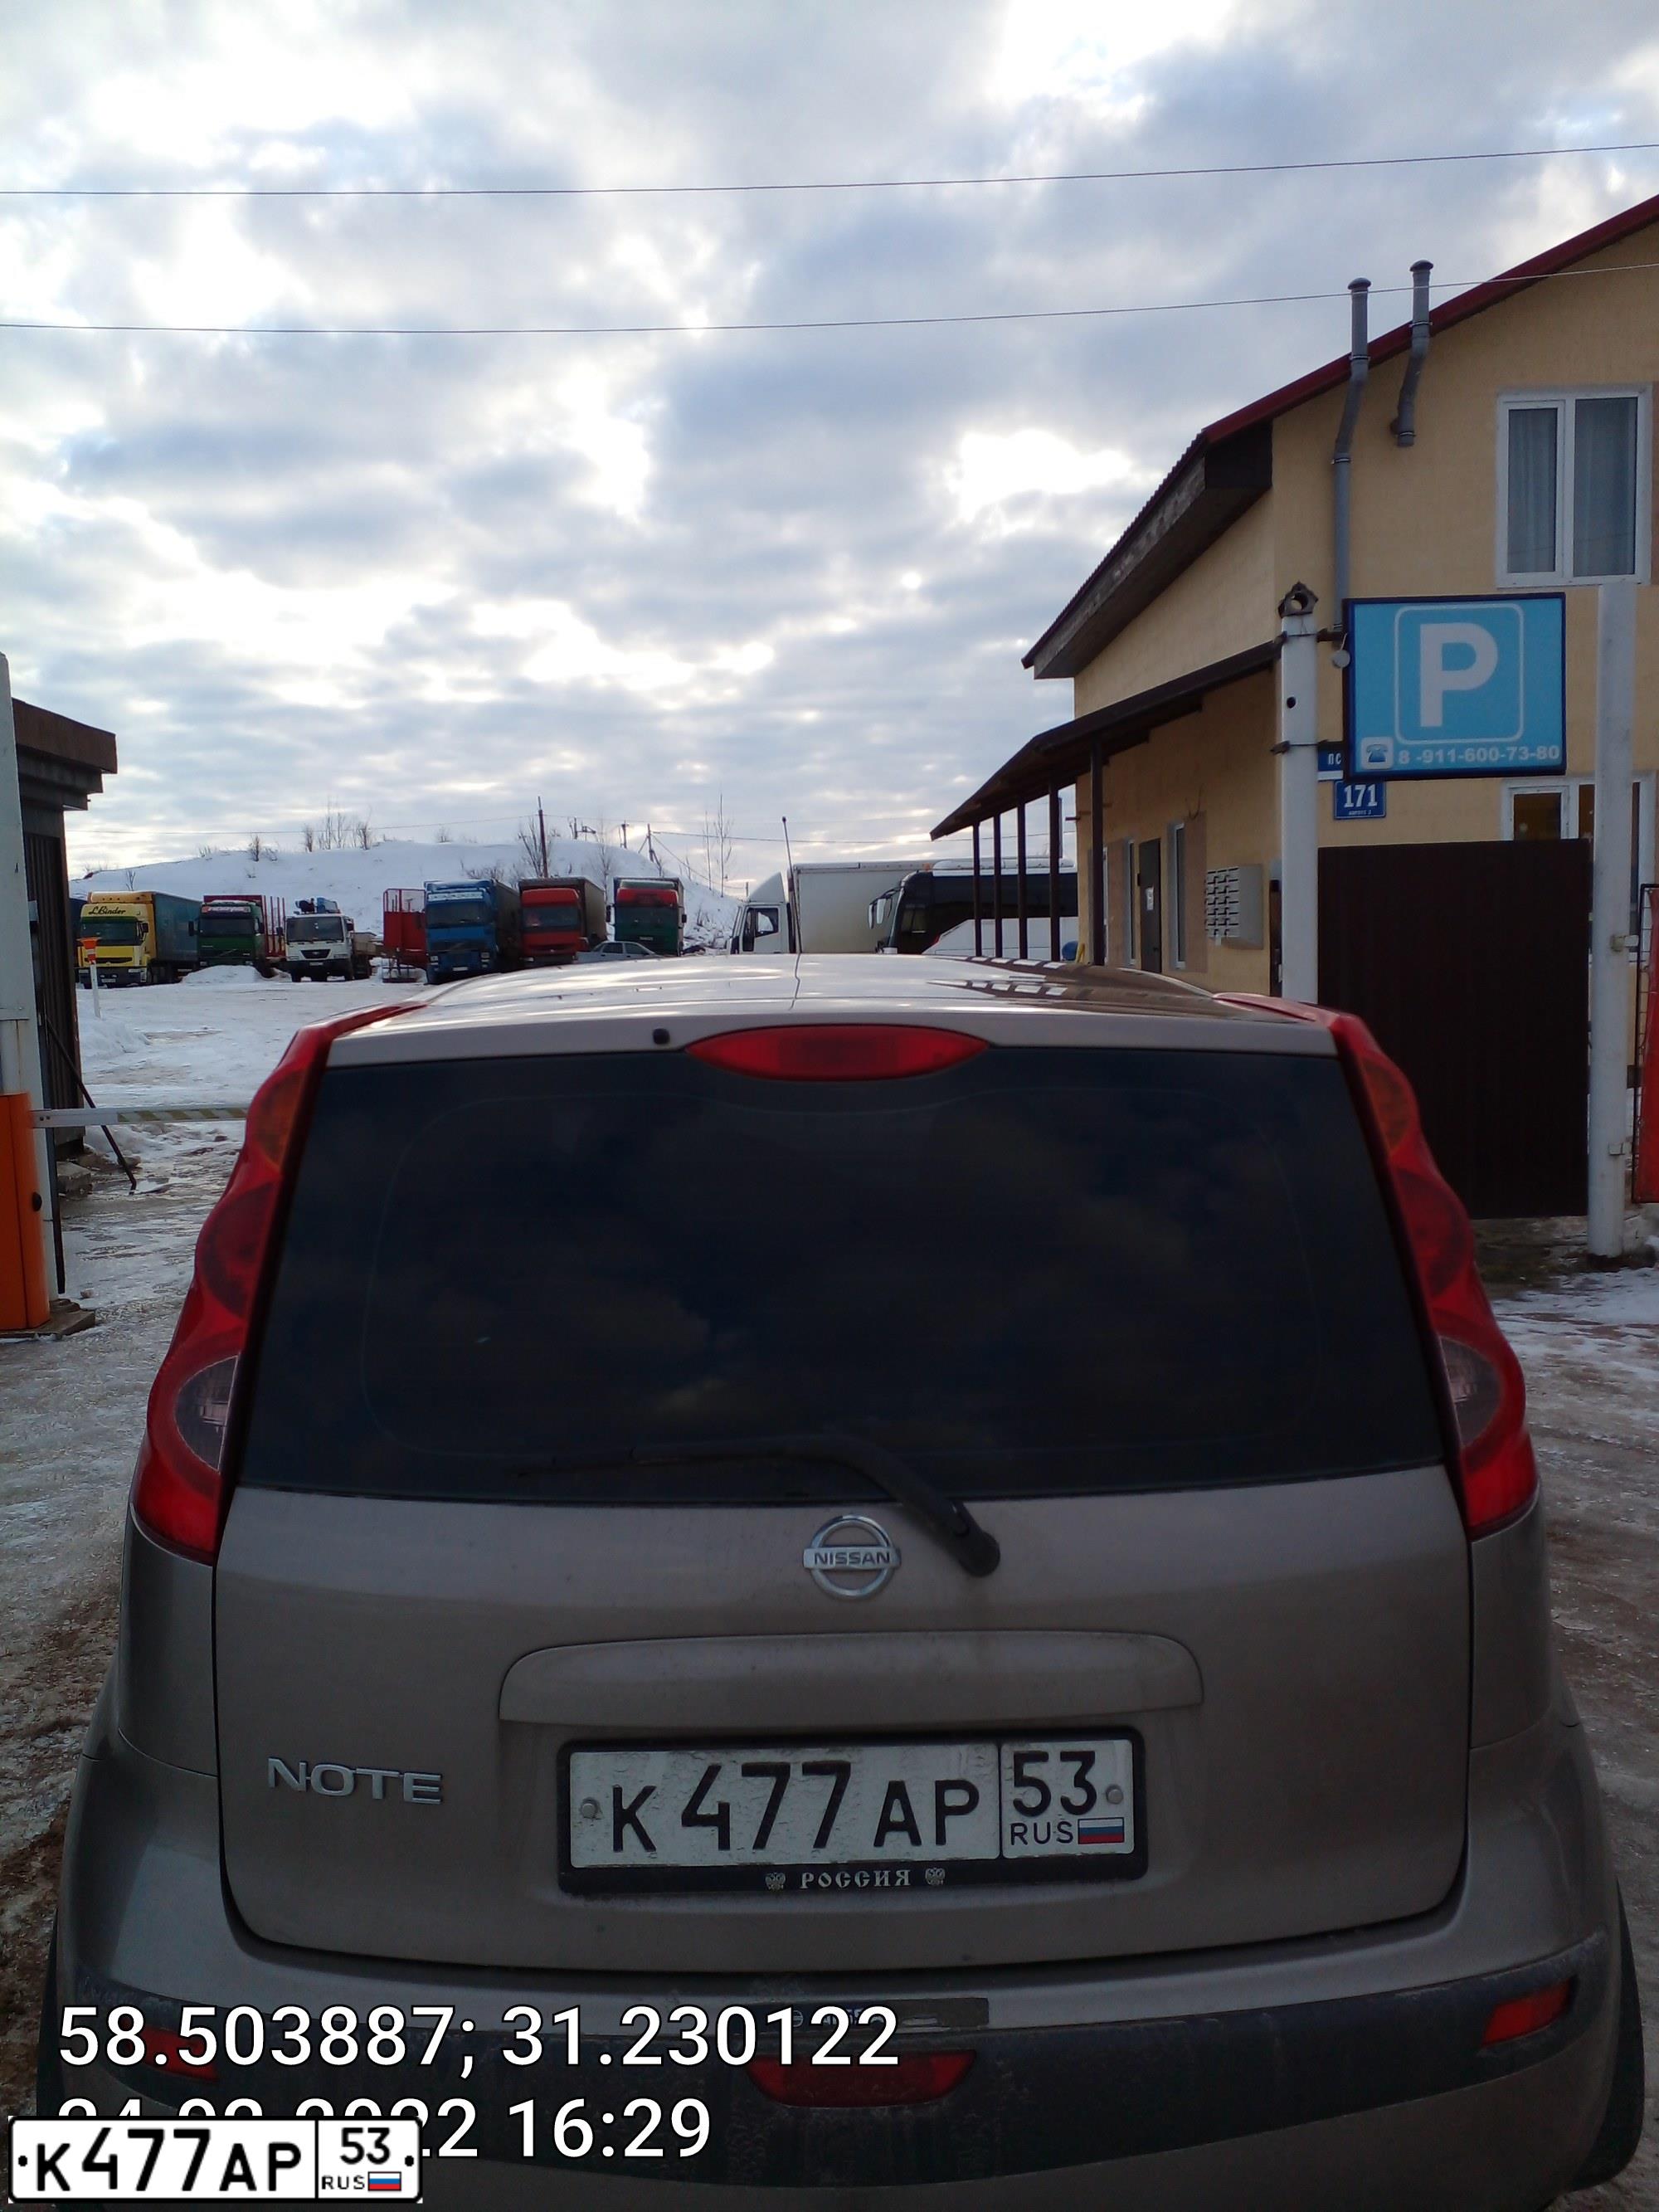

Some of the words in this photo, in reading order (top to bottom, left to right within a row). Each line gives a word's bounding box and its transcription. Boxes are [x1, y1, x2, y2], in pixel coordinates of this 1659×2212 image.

[1420, 622, 1498, 727] P
[1344, 784, 1378, 808] 171
[814, 1551, 891, 1566] NISSAN
[267, 1756, 442, 1805] NOTE
[1012, 1751, 1097, 1816] 53
[1010, 1821, 1074, 1845] RUS
[800, 1869, 912, 1889] РОССИЯ
